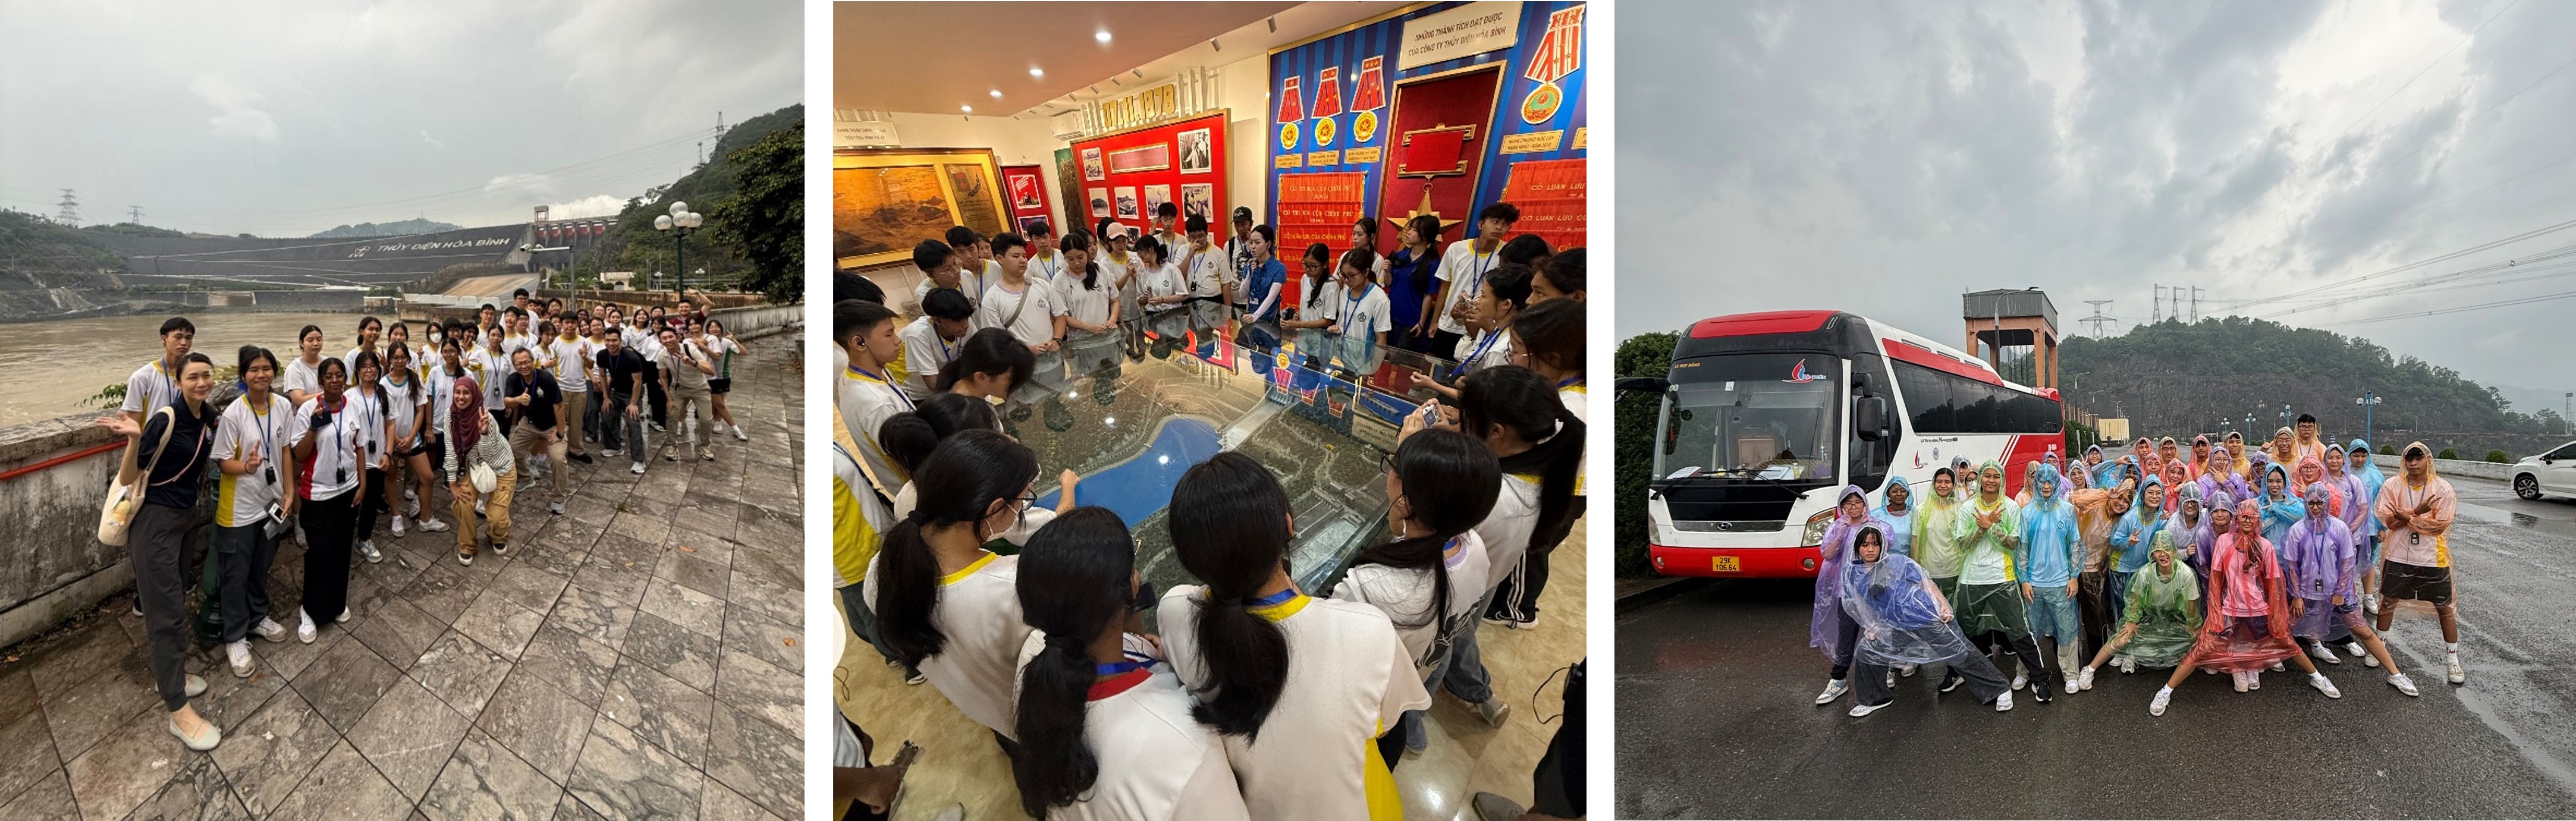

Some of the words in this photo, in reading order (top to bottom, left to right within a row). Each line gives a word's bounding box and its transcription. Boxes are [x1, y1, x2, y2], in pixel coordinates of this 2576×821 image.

[1435, 24, 1455, 37] THÀNH
[1456, 20, 1469, 31] TÍCH
[1469, 17, 1484, 29] ĐẠT
[1484, 11, 1503, 25] ĐƯỢC
[1436, 42, 1444, 50] TY
[1490, 26, 1506, 37] BÌNH
[411, 241, 441, 251] ĐIỆN
[442, 240, 472, 248] HÒA
[475, 238, 510, 247] BÌNH
